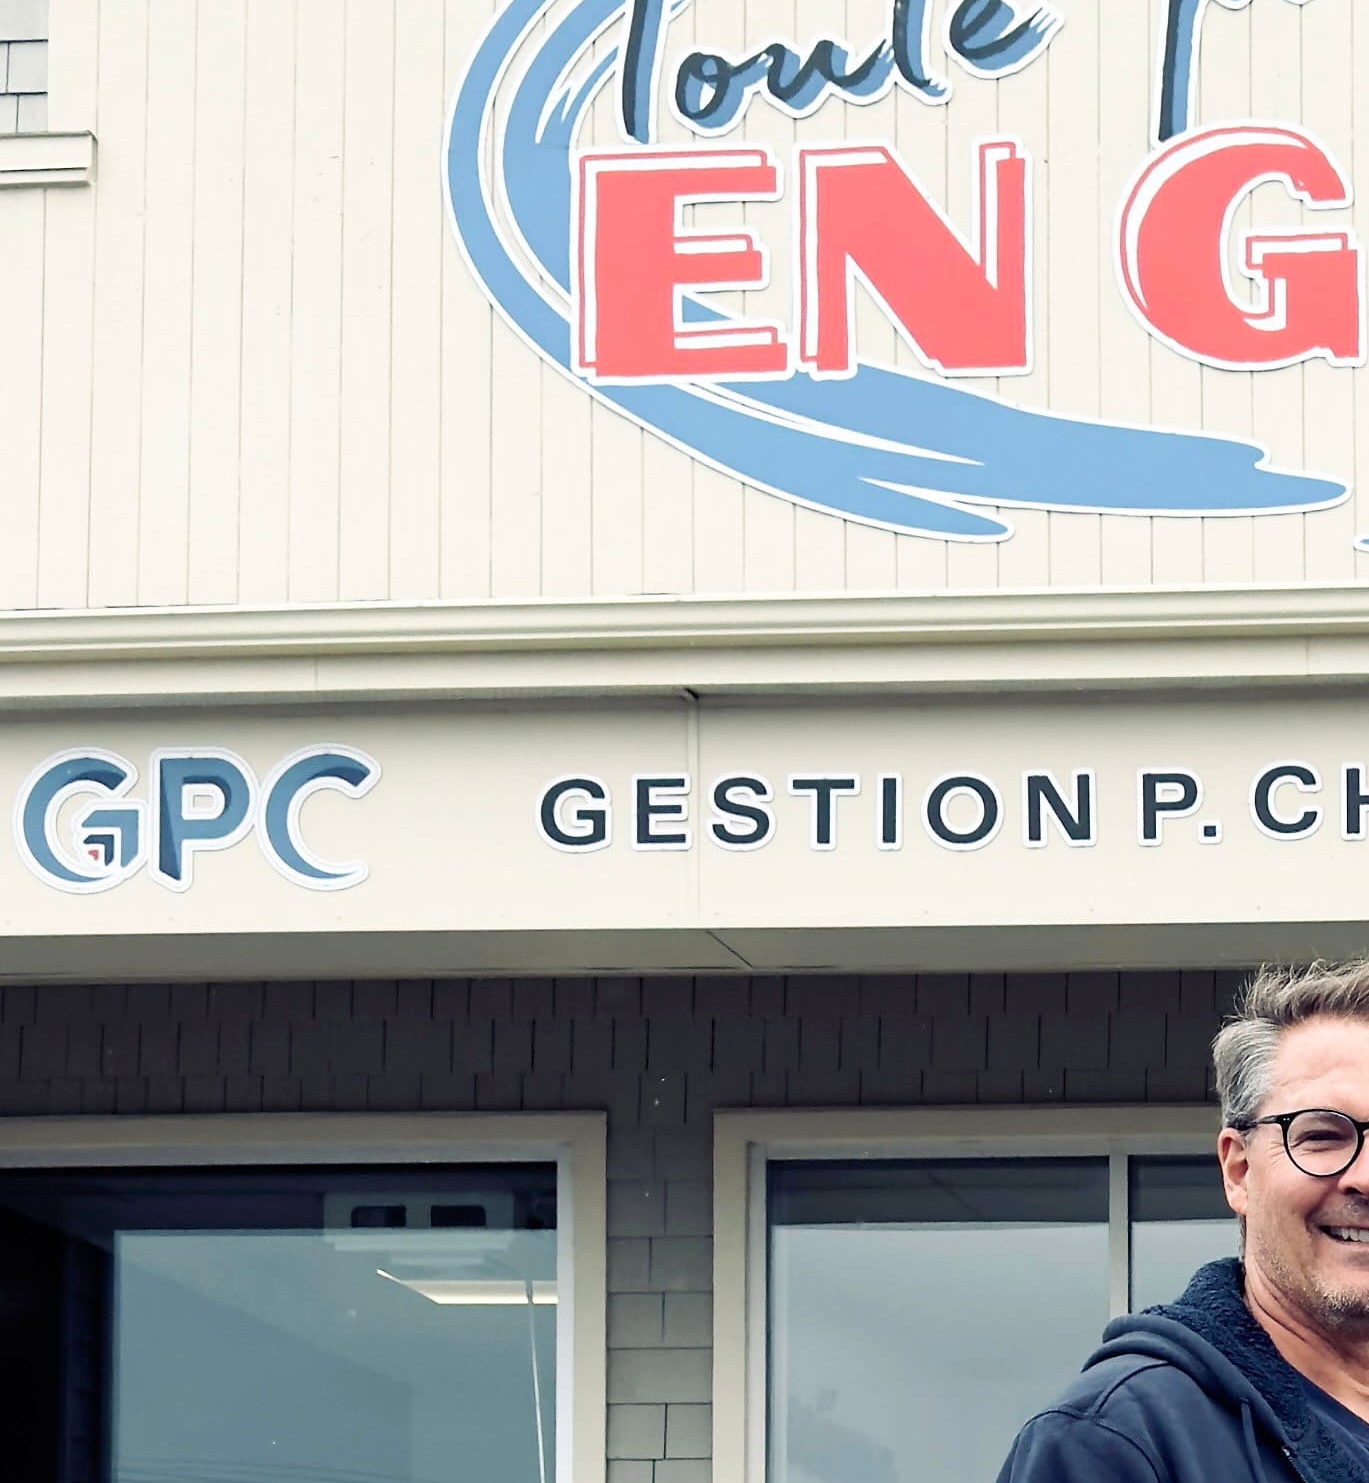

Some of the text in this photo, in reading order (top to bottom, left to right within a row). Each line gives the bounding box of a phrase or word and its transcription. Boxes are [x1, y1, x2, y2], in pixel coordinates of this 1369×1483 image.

[577, 139, 1030, 379] EN
[18, 749, 378, 889] GPC
[540, 774, 1092, 847] GESTION
[1142, 773, 1218, 840] P.
